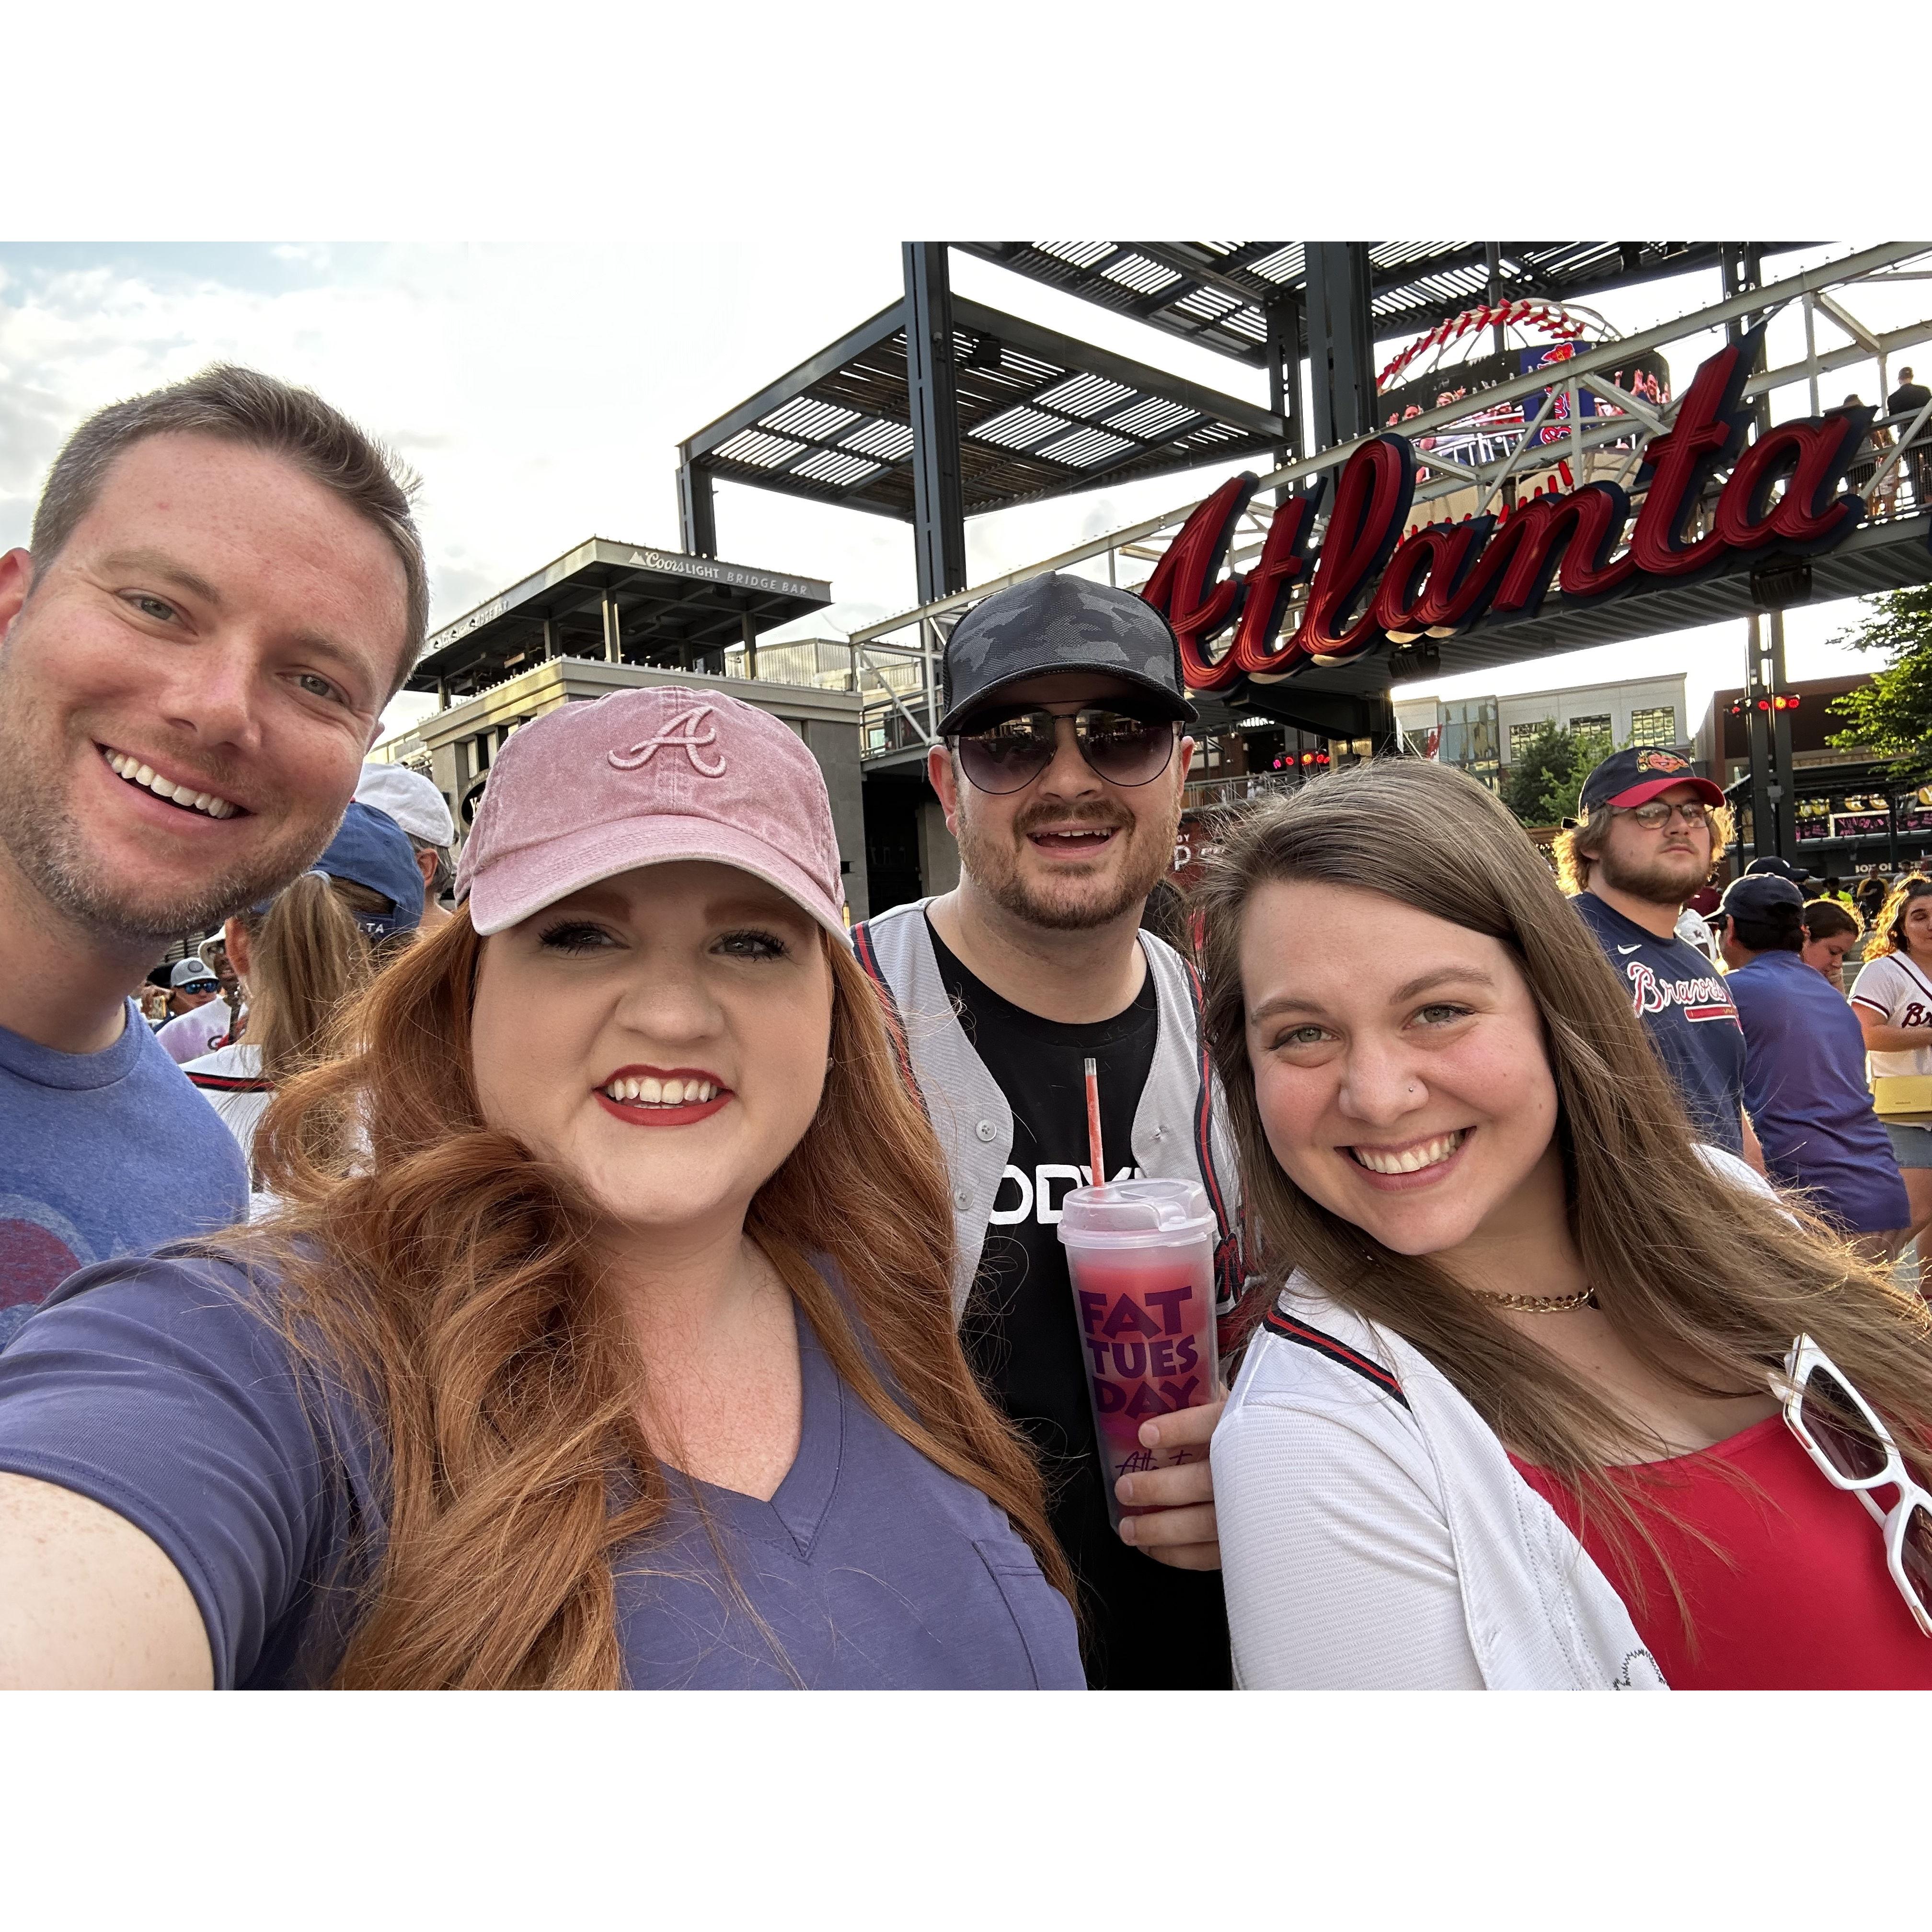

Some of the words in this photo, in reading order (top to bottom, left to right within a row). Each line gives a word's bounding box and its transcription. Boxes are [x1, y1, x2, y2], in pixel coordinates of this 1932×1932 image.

[1143, 331, 1864, 692] Atlanta
[645, 552, 687, 573] Coors
[686, 563, 719, 579] LIGHT
[726, 571, 776, 590] BRIDGE
[782, 581, 807, 596] BAR
[607, 706, 727, 779] A
[1626, 961, 1728, 1019] Braves
[1078, 1285, 1193, 1340] FAT
[1086, 1334, 1198, 1379] TUES
[1092, 1375, 1200, 1420] DAY
